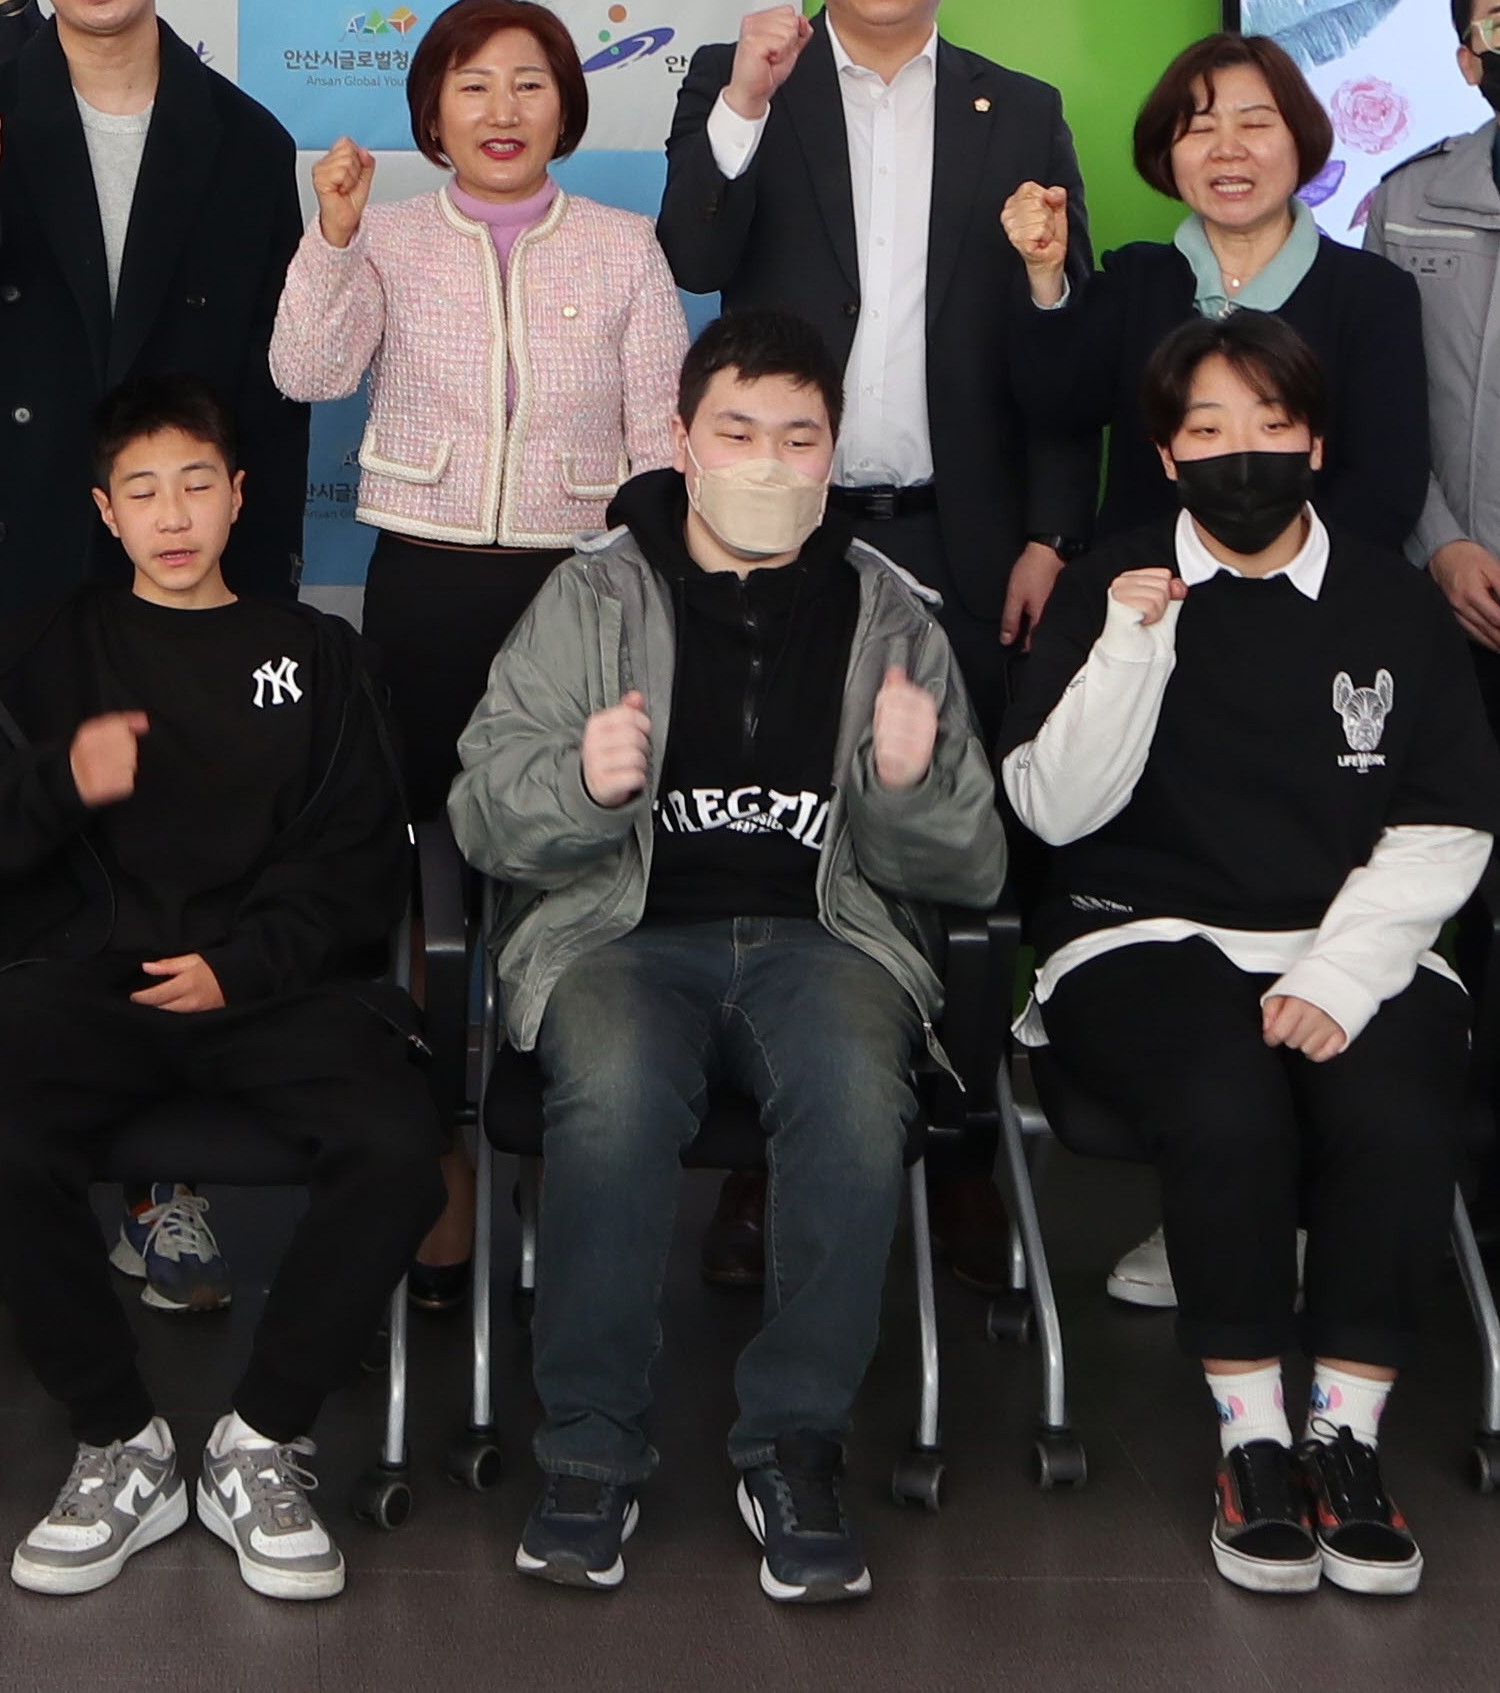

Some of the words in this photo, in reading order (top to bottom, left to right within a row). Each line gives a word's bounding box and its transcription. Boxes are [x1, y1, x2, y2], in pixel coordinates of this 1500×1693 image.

[283, 49, 410, 70] 안산시글로벌청
[306, 75, 341, 86] Ansan
[344, 75, 380, 86] Global
[251, 656, 303, 709] NY
